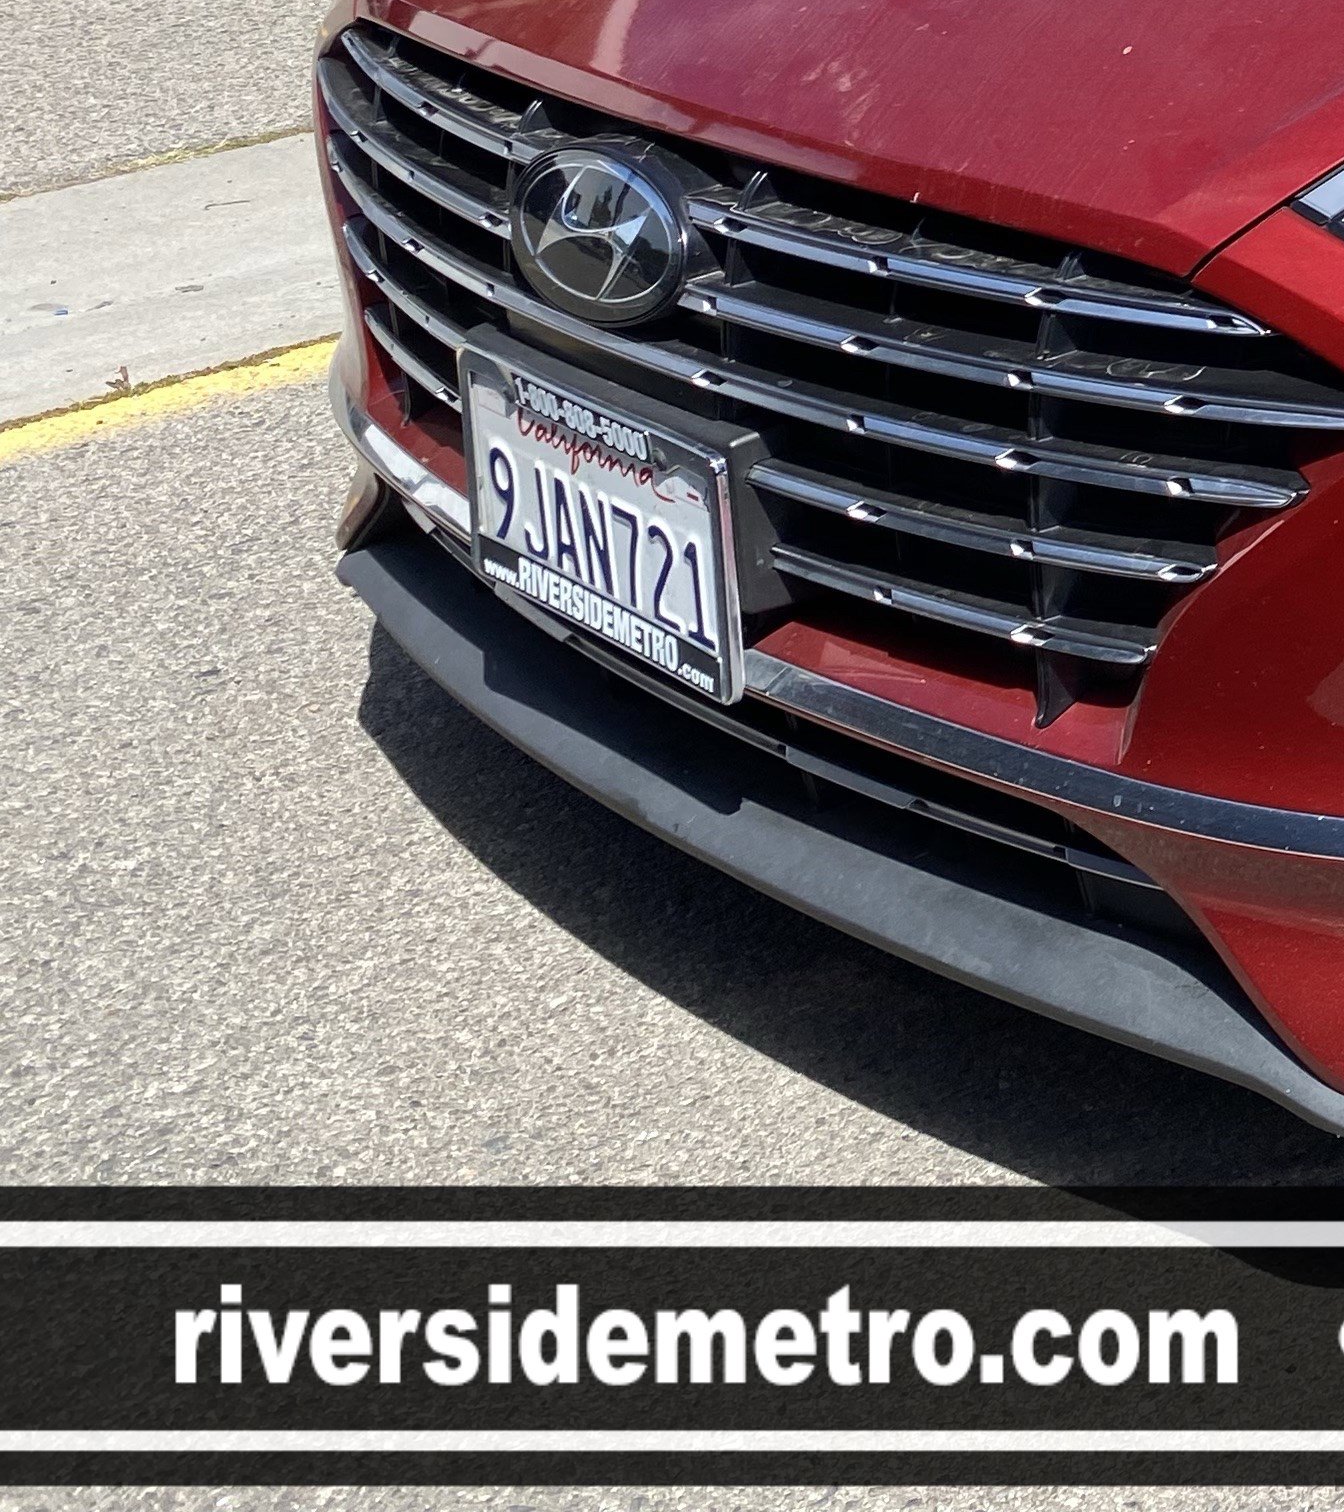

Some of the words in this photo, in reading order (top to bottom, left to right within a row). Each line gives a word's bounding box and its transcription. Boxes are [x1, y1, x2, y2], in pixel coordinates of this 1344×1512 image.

[514, 376, 648, 462] 1-800-808-5000
[517, 406, 677, 504] California
[488, 444, 717, 651] 9JAN721
[483, 557, 715, 694] www.RIVERSIDEMETRO.com
